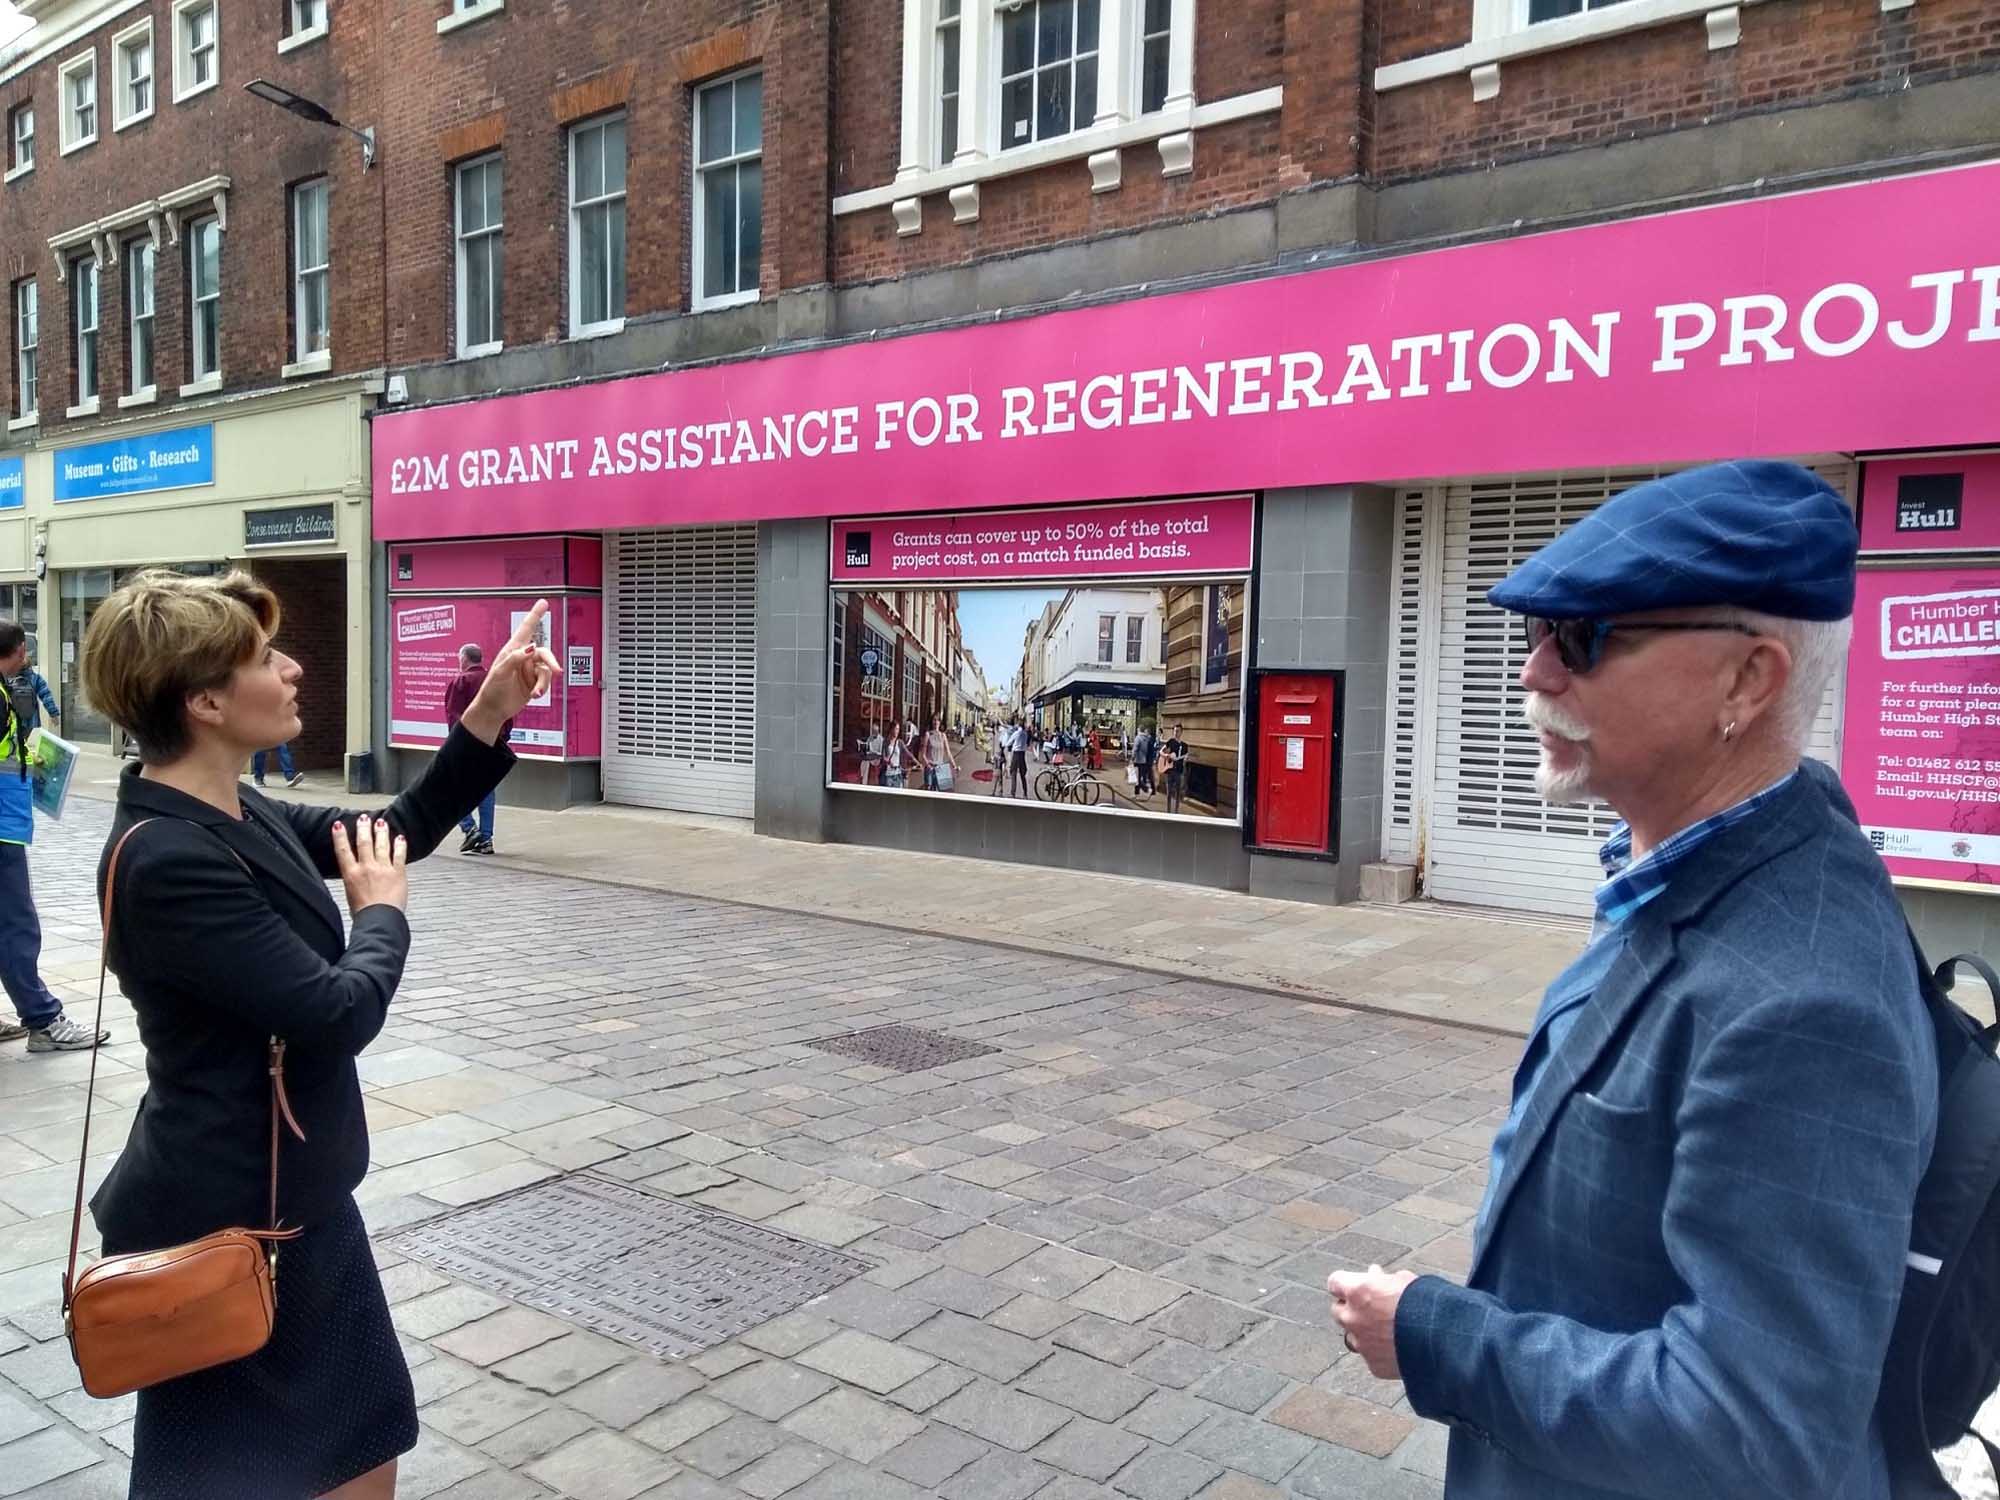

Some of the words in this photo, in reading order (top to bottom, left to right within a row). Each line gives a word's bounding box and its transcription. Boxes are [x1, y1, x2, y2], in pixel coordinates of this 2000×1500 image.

[391, 454, 449, 494] £2M
[458, 440, 578, 487] GRANT
[588, 407, 859, 476] ASSISTANCE
[875, 394, 983, 450] FOR
[1000, 311, 1620, 438] REGENERATION
[64, 463, 103, 480] Museum
[112, 455, 138, 473] Gifts
[149, 445, 199, 468] Research
[0, 472, 21, 489] orial
[1901, 501, 1926, 510] Invest
[1900, 509, 1955, 529] Hull
[893, 532, 941, 547] Grants
[945, 532, 972, 546] can
[976, 530, 1017, 544] cover
[1021, 528, 1041, 546] up
[1045, 526, 1062, 541] to
[1065, 522, 1104, 540] 50%
[1109, 519, 1127, 537] of
[1131, 518, 1160, 536] the
[1165, 515, 1209, 534] total
[847, 553, 869, 566] Hull
[892, 551, 940, 569] project
[943, 550, 977, 567] cost,
[981, 551, 1000, 565] on
[1004, 551, 1014, 564] a
[1018, 545, 1070, 562] match
[1074, 542, 1134, 561] funded
[1138, 540, 1191, 559] basis.
[1911, 602, 1988, 621] Humber
[1882, 681, 1907, 693] For
[1909, 682, 1964, 695] further
[1967, 682, 2000, 695] info
[1881, 696, 1905, 708] for
[1906, 699, 1916, 708] a
[1919, 698, 1961, 712] grant
[1964, 698, 2000, 712] plea
[1880, 711, 1941, 724] Humber
[1944, 713, 1981, 728] High
[1880, 727, 1918, 738] team
[1921, 729, 1944, 739] on:
[1878, 756, 1903, 768] Tel:
[1906, 757, 1951, 770] 01482
[1955, 759, 1981, 771] 612
[1877, 770, 1924, 783] Email:
[1927, 773, 2000, 790] HHSCF@
[1876, 785, 2000, 803] hull.gov.uk/HHS
[1886, 833, 1909, 844] Hull
